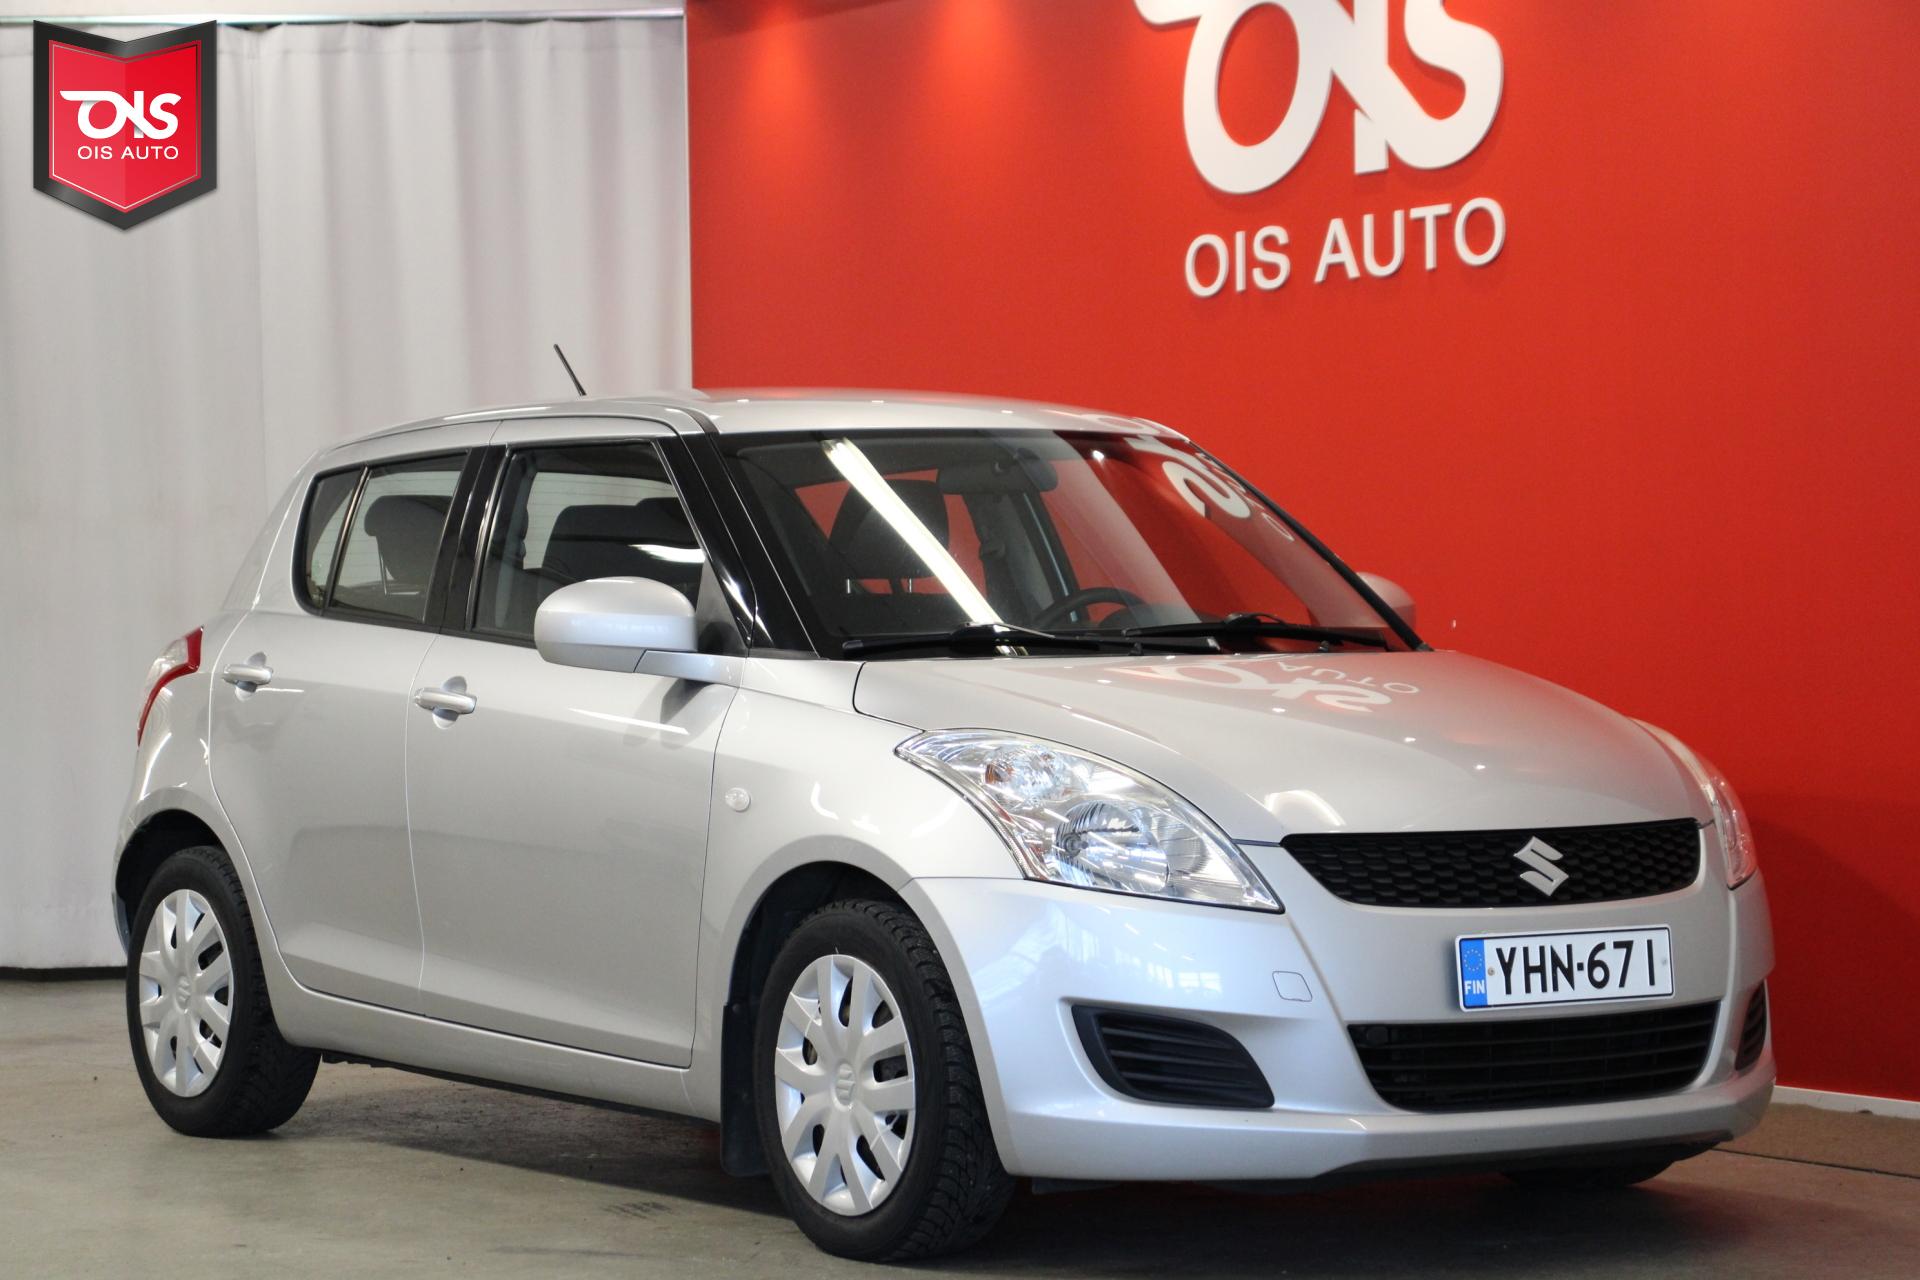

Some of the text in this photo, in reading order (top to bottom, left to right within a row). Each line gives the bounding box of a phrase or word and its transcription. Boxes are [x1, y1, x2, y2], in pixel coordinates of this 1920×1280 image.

[1184, 197, 1506, 297] OIS AUTO
[1464, 980, 1486, 995] FIN
[1496, 939, 1655, 995] YHN-671
